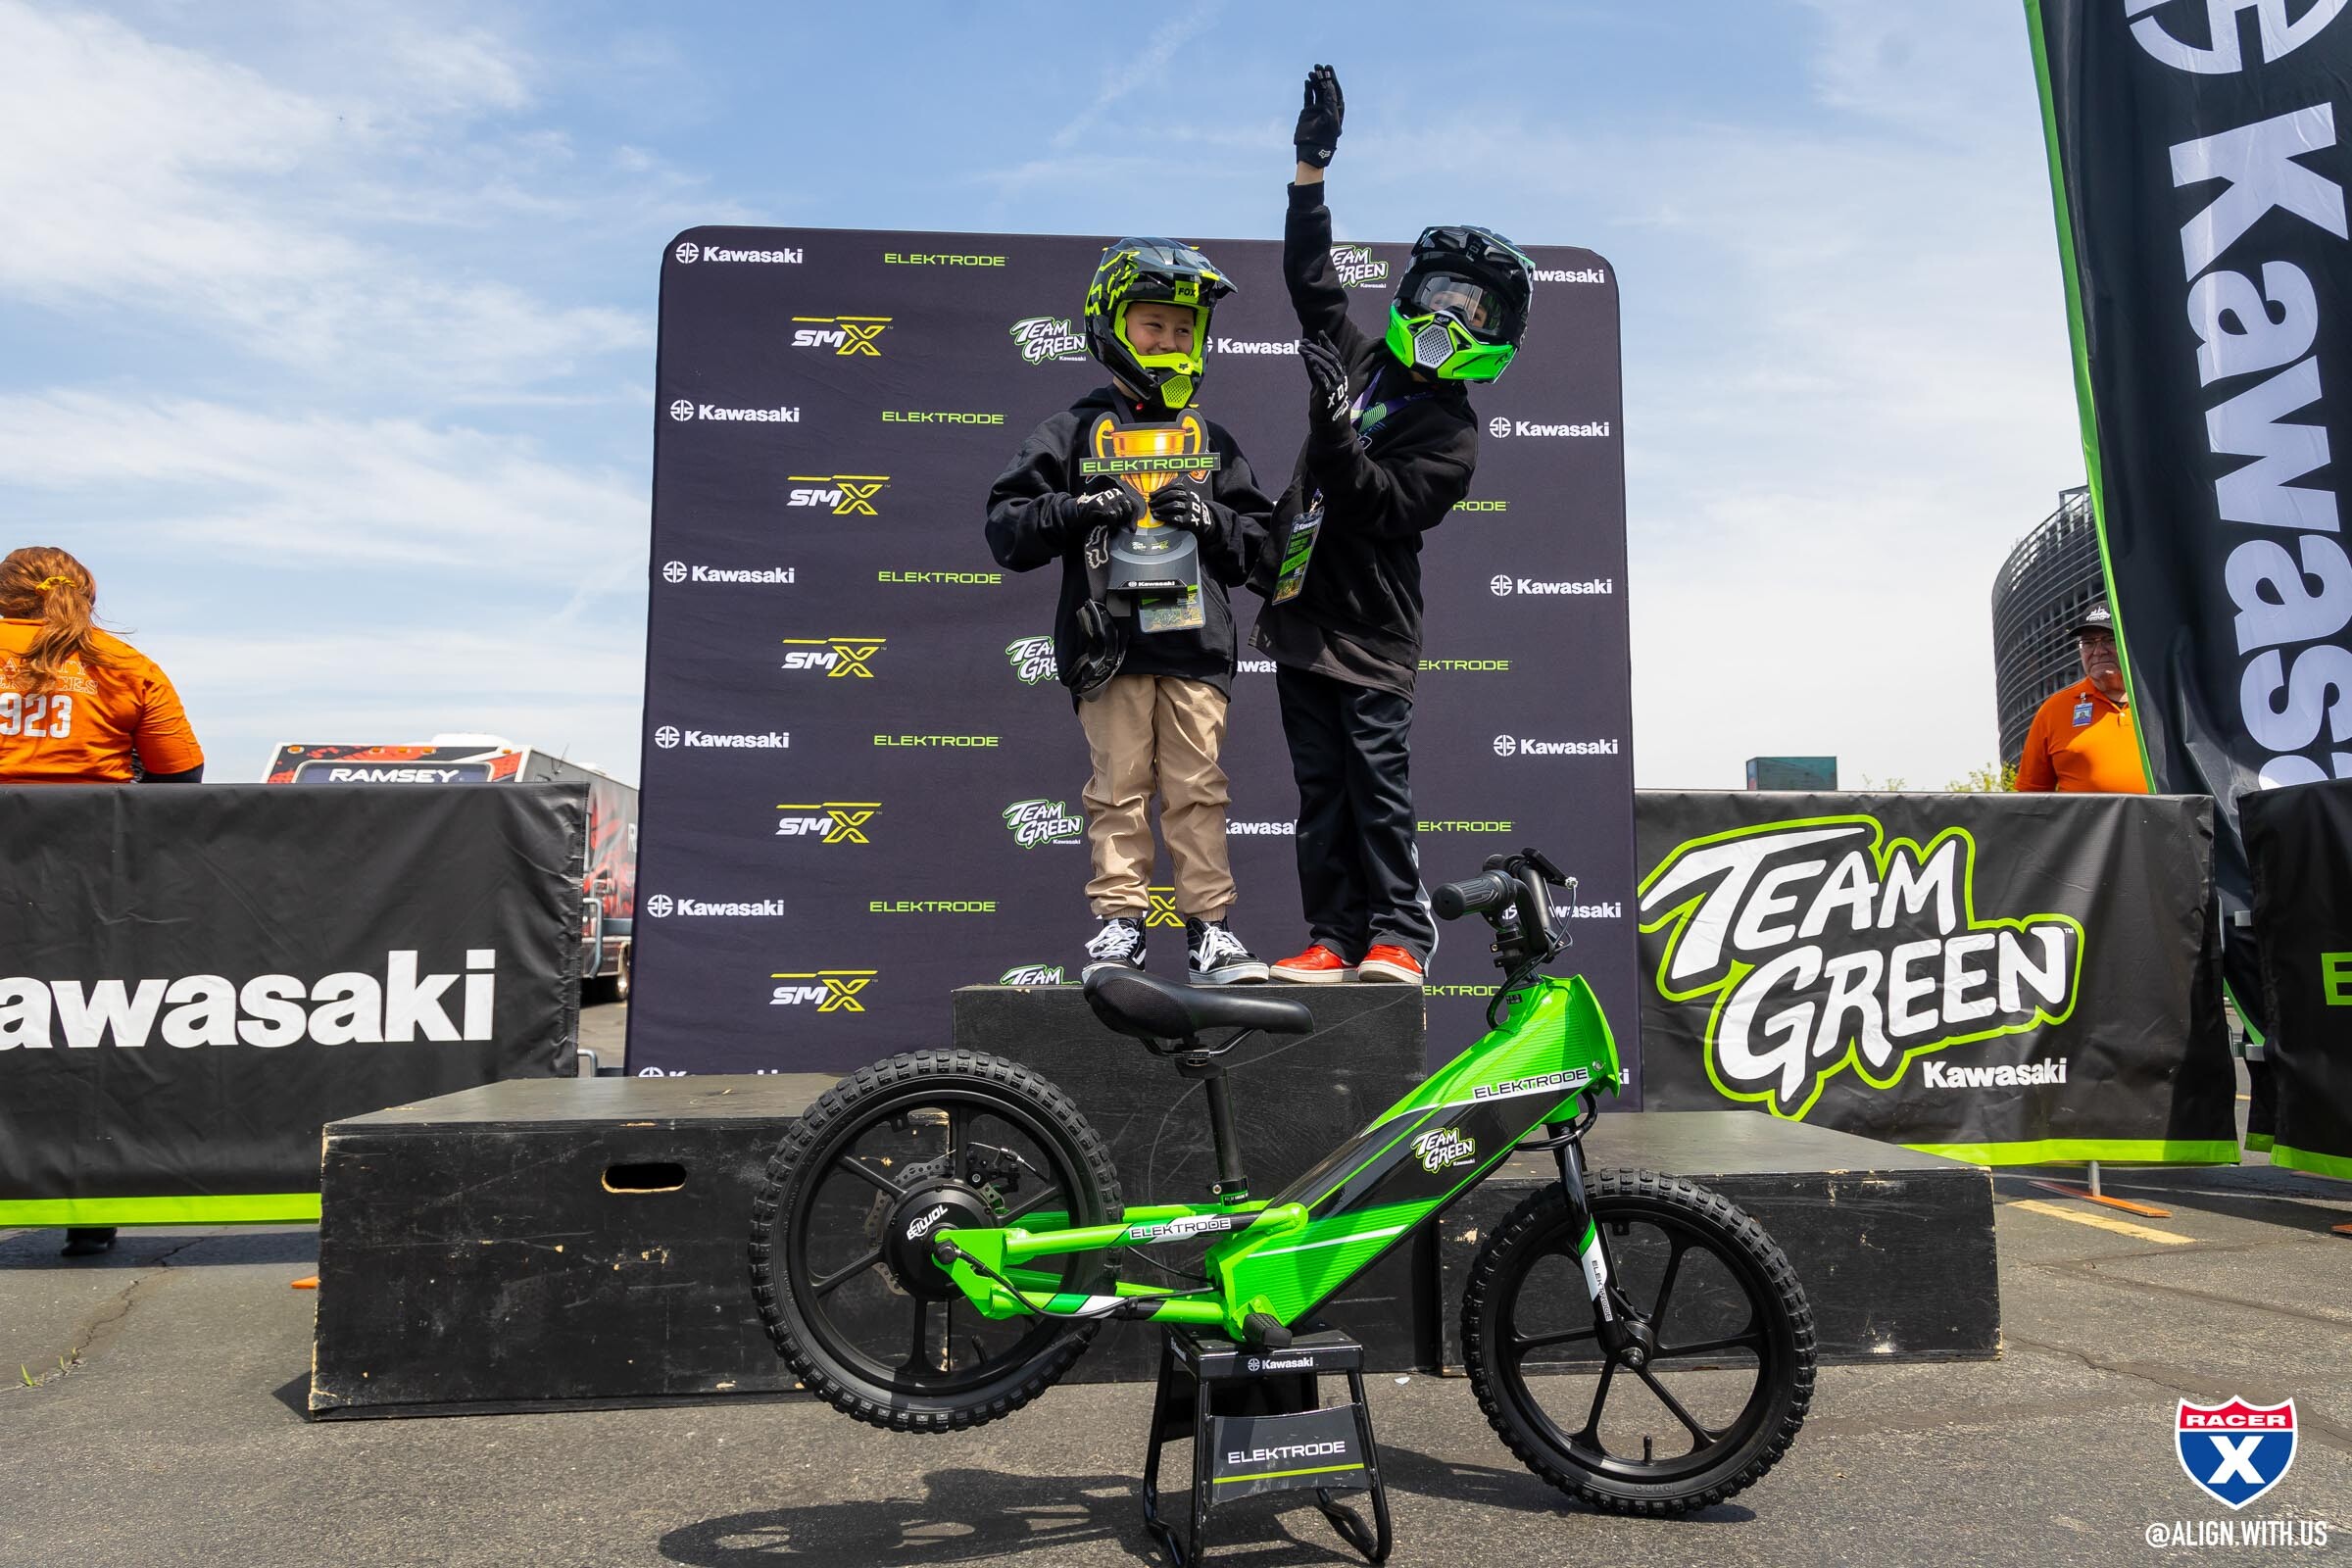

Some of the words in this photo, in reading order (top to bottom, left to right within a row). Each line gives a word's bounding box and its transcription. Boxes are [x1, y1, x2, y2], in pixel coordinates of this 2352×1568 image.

[704, 246, 803, 265] Kawasaki
[884, 253, 1005, 267] ELEKTRODE
[1330, 248, 1368, 266] EAM
[1534, 269, 1605, 284] wasaki
[1012, 318, 1068, 343] TEAM
[791, 324, 886, 357] SMX
[1024, 336, 1086, 362] GREEN
[1218, 338, 1300, 355] Kawasa
[699, 405, 800, 423] Kawasaki
[882, 412, 1004, 424] ELEKTRODE
[1516, 420, 1609, 437] Kawasaki
[2169, 102, 2352, 790] Kawas
[1083, 457, 1214, 473] ELEKTRODE
[787, 484, 883, 516] SMX
[1097, 488, 1123, 506] FOX
[692, 566, 795, 584] Kawasaki
[878, 571, 1002, 584] ELEKTRODE
[1517, 578, 1613, 595] Kawasaki
[782, 646, 879, 677] SMX
[1020, 657, 1058, 682] GRE
[1418, 661, 1509, 671] EKTRODE
[685, 730, 790, 749] Kawasaki
[874, 735, 999, 747] ELEKTRODE
[1521, 739, 1619, 755] Kawasaki
[328, 768, 460, 783] RAMSEY
[1004, 802, 1063, 825] TEAM
[776, 810, 874, 844] SMX
[1017, 817, 1081, 846] GREEN
[1226, 818, 1298, 835] awasa
[1417, 820, 1512, 832] EKTRODE
[677, 900, 784, 917] Kawasaki
[869, 901, 997, 913] ELEKTRODE
[1548, 903, 1622, 918] wasaki
[1640, 828, 1956, 980] TEAM
[769, 978, 870, 1012] SMX
[1423, 985, 1500, 997] EKTROD
[0, 950, 496, 1051] awasaki
[1718, 926, 2066, 1102] GREEN
[1923, 1058, 2067, 1088] Kawasaki
[1474, 1068, 1588, 1099] ELEKTRODE
[1412, 1130, 1458, 1155] TEAM
[1425, 1141, 1473, 1170] GREEN
[1131, 1219, 1230, 1238] ELEKTRODE
[1592, 1260, 1612, 1320] ELEKTRODE
[1262, 1356, 1314, 1370] Kawasaki
[1227, 1441, 1346, 1464] ELEKTRODE
